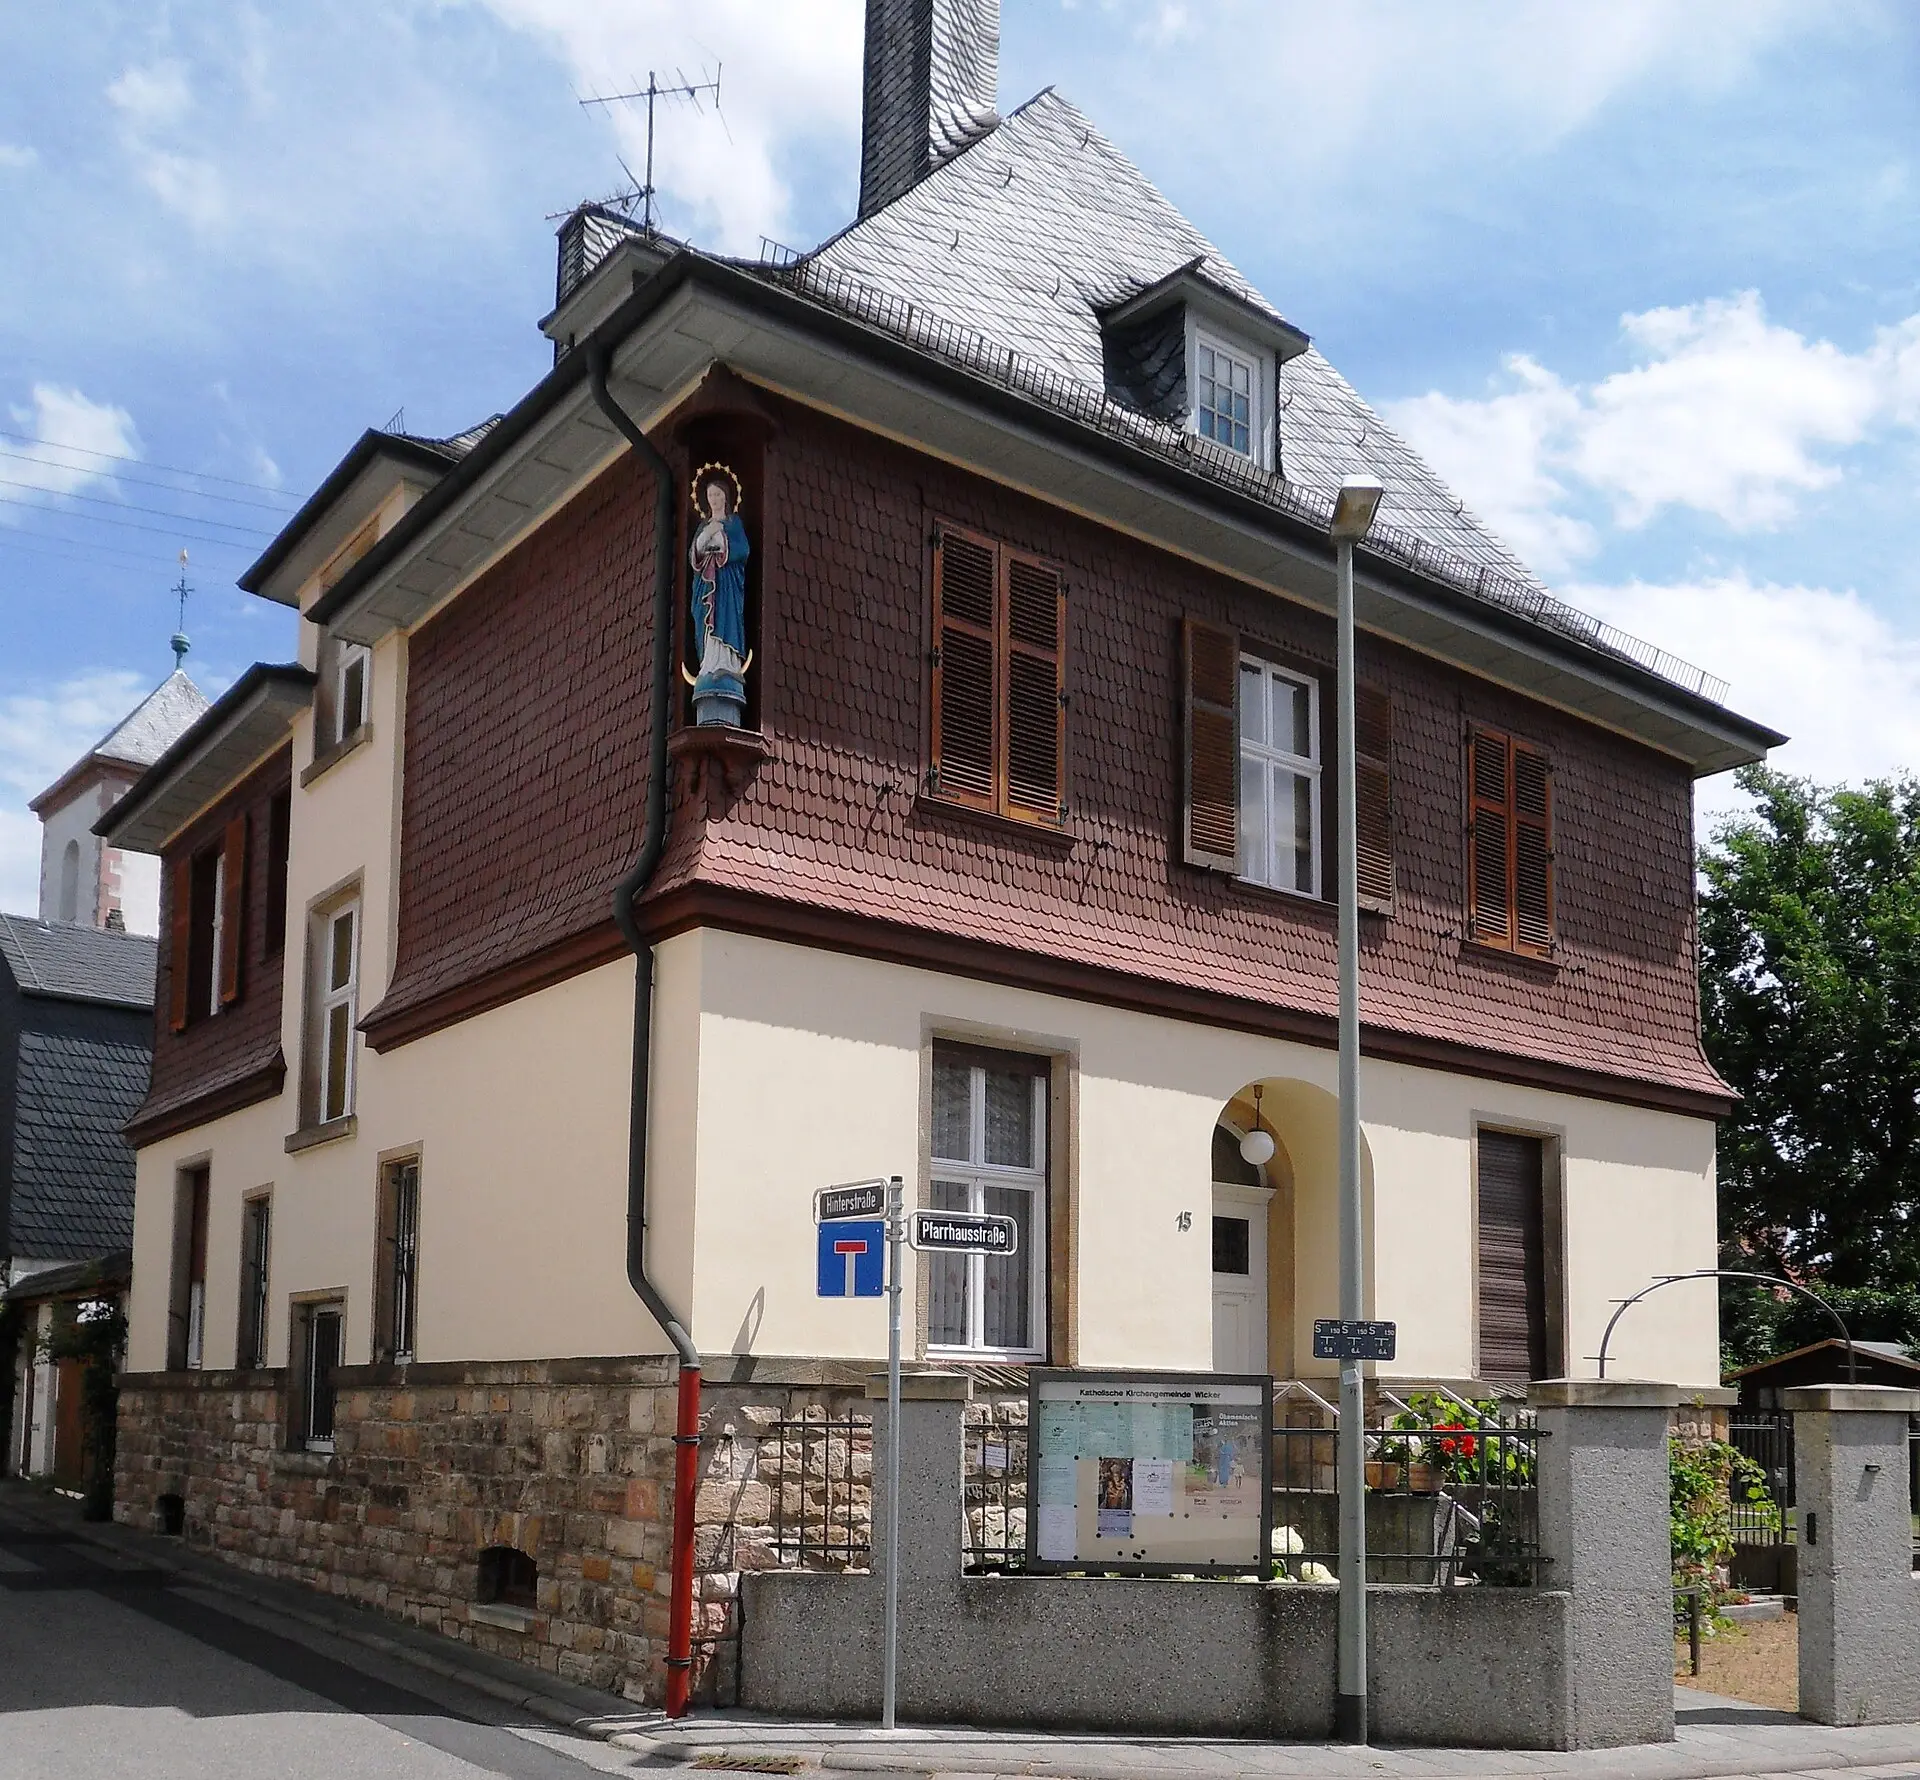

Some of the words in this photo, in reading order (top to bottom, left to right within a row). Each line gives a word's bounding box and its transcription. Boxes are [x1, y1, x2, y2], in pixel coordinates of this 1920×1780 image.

[826, 1190, 876, 1214] Hinterstraße
[1175, 1210, 1192, 1232] 15
[922, 1222, 1005, 1244] Pfarrhausstraße
[1315, 1324, 1322, 1333] S
[1341, 1325, 1349, 1334] S
[1368, 1326, 1376, 1335] S
[1126, 1389, 1191, 1398] Kirchengemeinde
[1194, 1390, 1221, 1398] Wicker
